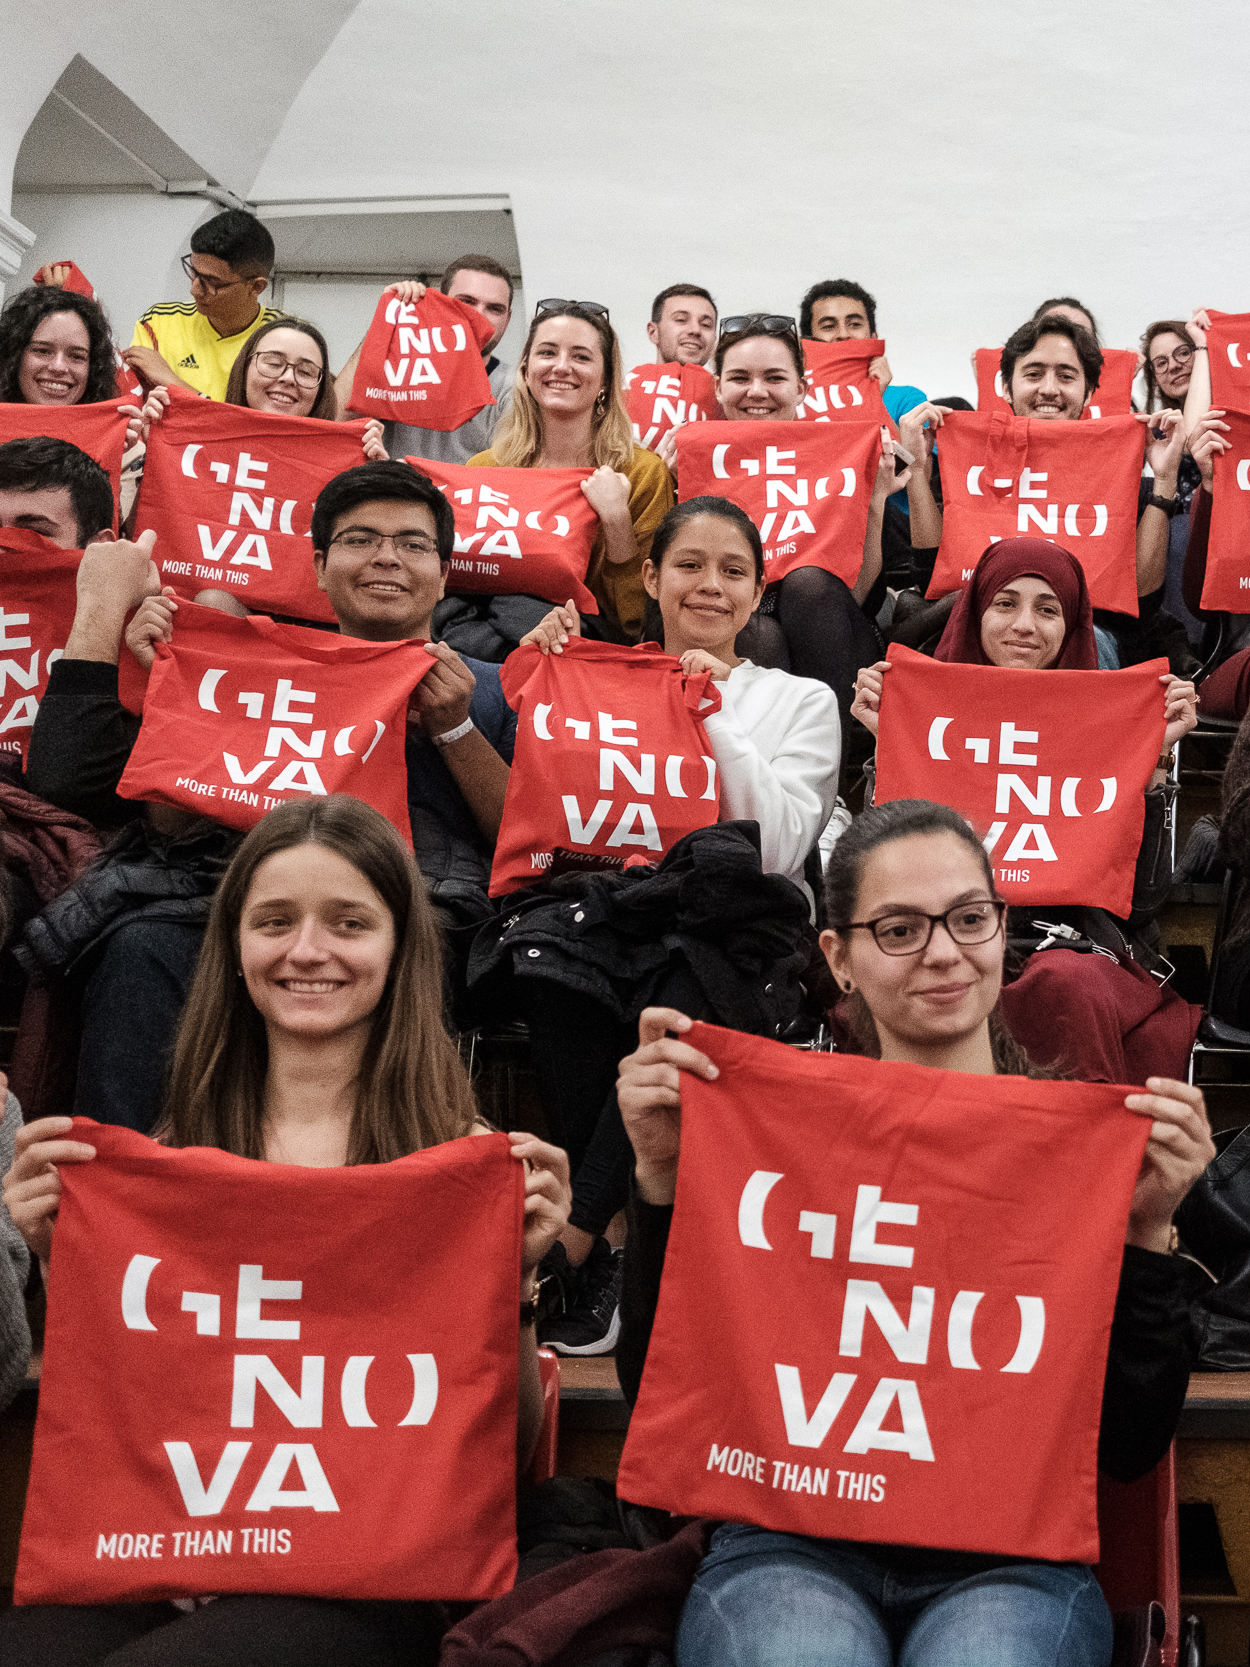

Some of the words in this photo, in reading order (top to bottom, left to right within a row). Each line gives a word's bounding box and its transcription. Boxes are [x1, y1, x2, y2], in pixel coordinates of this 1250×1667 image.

[398, 324, 466, 354] NO
[384, 357, 441, 386] VA
[388, 390, 408, 402] THAN
[408, 390, 428, 400] THIS
[181, 444, 268, 490] GE
[712, 444, 796, 478] GE
[766, 468, 856, 508] NO
[476, 506, 570, 537] NO
[1017, 504, 1108, 536] NO
[197, 524, 272, 570] VA
[452, 530, 522, 559] VA
[776, 542, 796, 558] THIS
[162, 560, 192, 576] MORE
[195, 564, 223, 580] THAN
[226, 570, 250, 586] THIS
[451, 558, 473, 572] HAN
[476, 562, 500, 576] THIS
[0, 606, 32, 650] E
[0, 694, 40, 734] A
[198, 668, 316, 724] GE
[264, 720, 386, 764] NO
[533, 702, 638, 747] GE
[928, 716, 1039, 766] GE
[176, 776, 218, 798] MORE
[221, 787, 259, 808] THAN
[263, 796, 286, 811] TH
[222, 752, 328, 796] VA
[599, 748, 716, 800] NO
[994, 773, 1118, 818] NO
[562, 794, 664, 852] VA
[530, 852, 554, 870] MOR
[560, 850, 596, 862] THAN
[1000, 868, 1030, 883] THIS
[738, 1170, 919, 1268] GE
[121, 1254, 302, 1340] GE
[839, 1278, 1046, 1374] NO
[230, 1353, 439, 1428] NO
[774, 1363, 936, 1462] VA
[164, 1442, 340, 1516] VA
[706, 1444, 766, 1484] MORE
[772, 1460, 828, 1496] THAN
[836, 1470, 886, 1503] THIS
[96, 1533, 164, 1559] MORE
[172, 1529, 232, 1556] THAN
[240, 1528, 292, 1554] THIS
